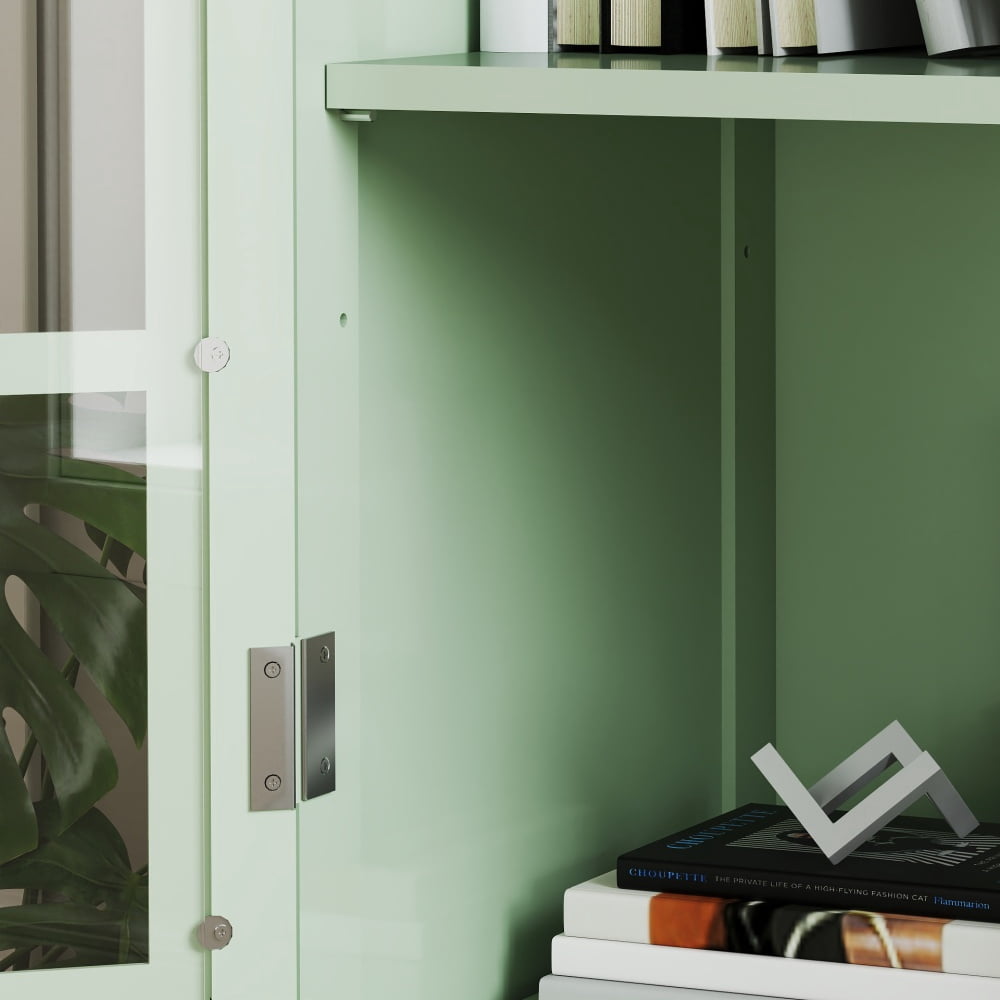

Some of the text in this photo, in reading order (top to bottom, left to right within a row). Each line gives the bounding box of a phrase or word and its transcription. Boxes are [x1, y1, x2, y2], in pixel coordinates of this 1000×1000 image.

[628, 866, 708, 884] CHOUPETTE
[714, 874, 731, 884] THE
[733, 876, 769, 888] PRIVATE
[770, 880, 789, 889] LIFE
[791, 882, 803, 890] OF
[814, 884, 868, 897] HIGH-FLYING
[871, 890, 909, 901] FASHION
[911, 894, 929, 902] CAT
[933, 896, 991, 911] Flammarion
